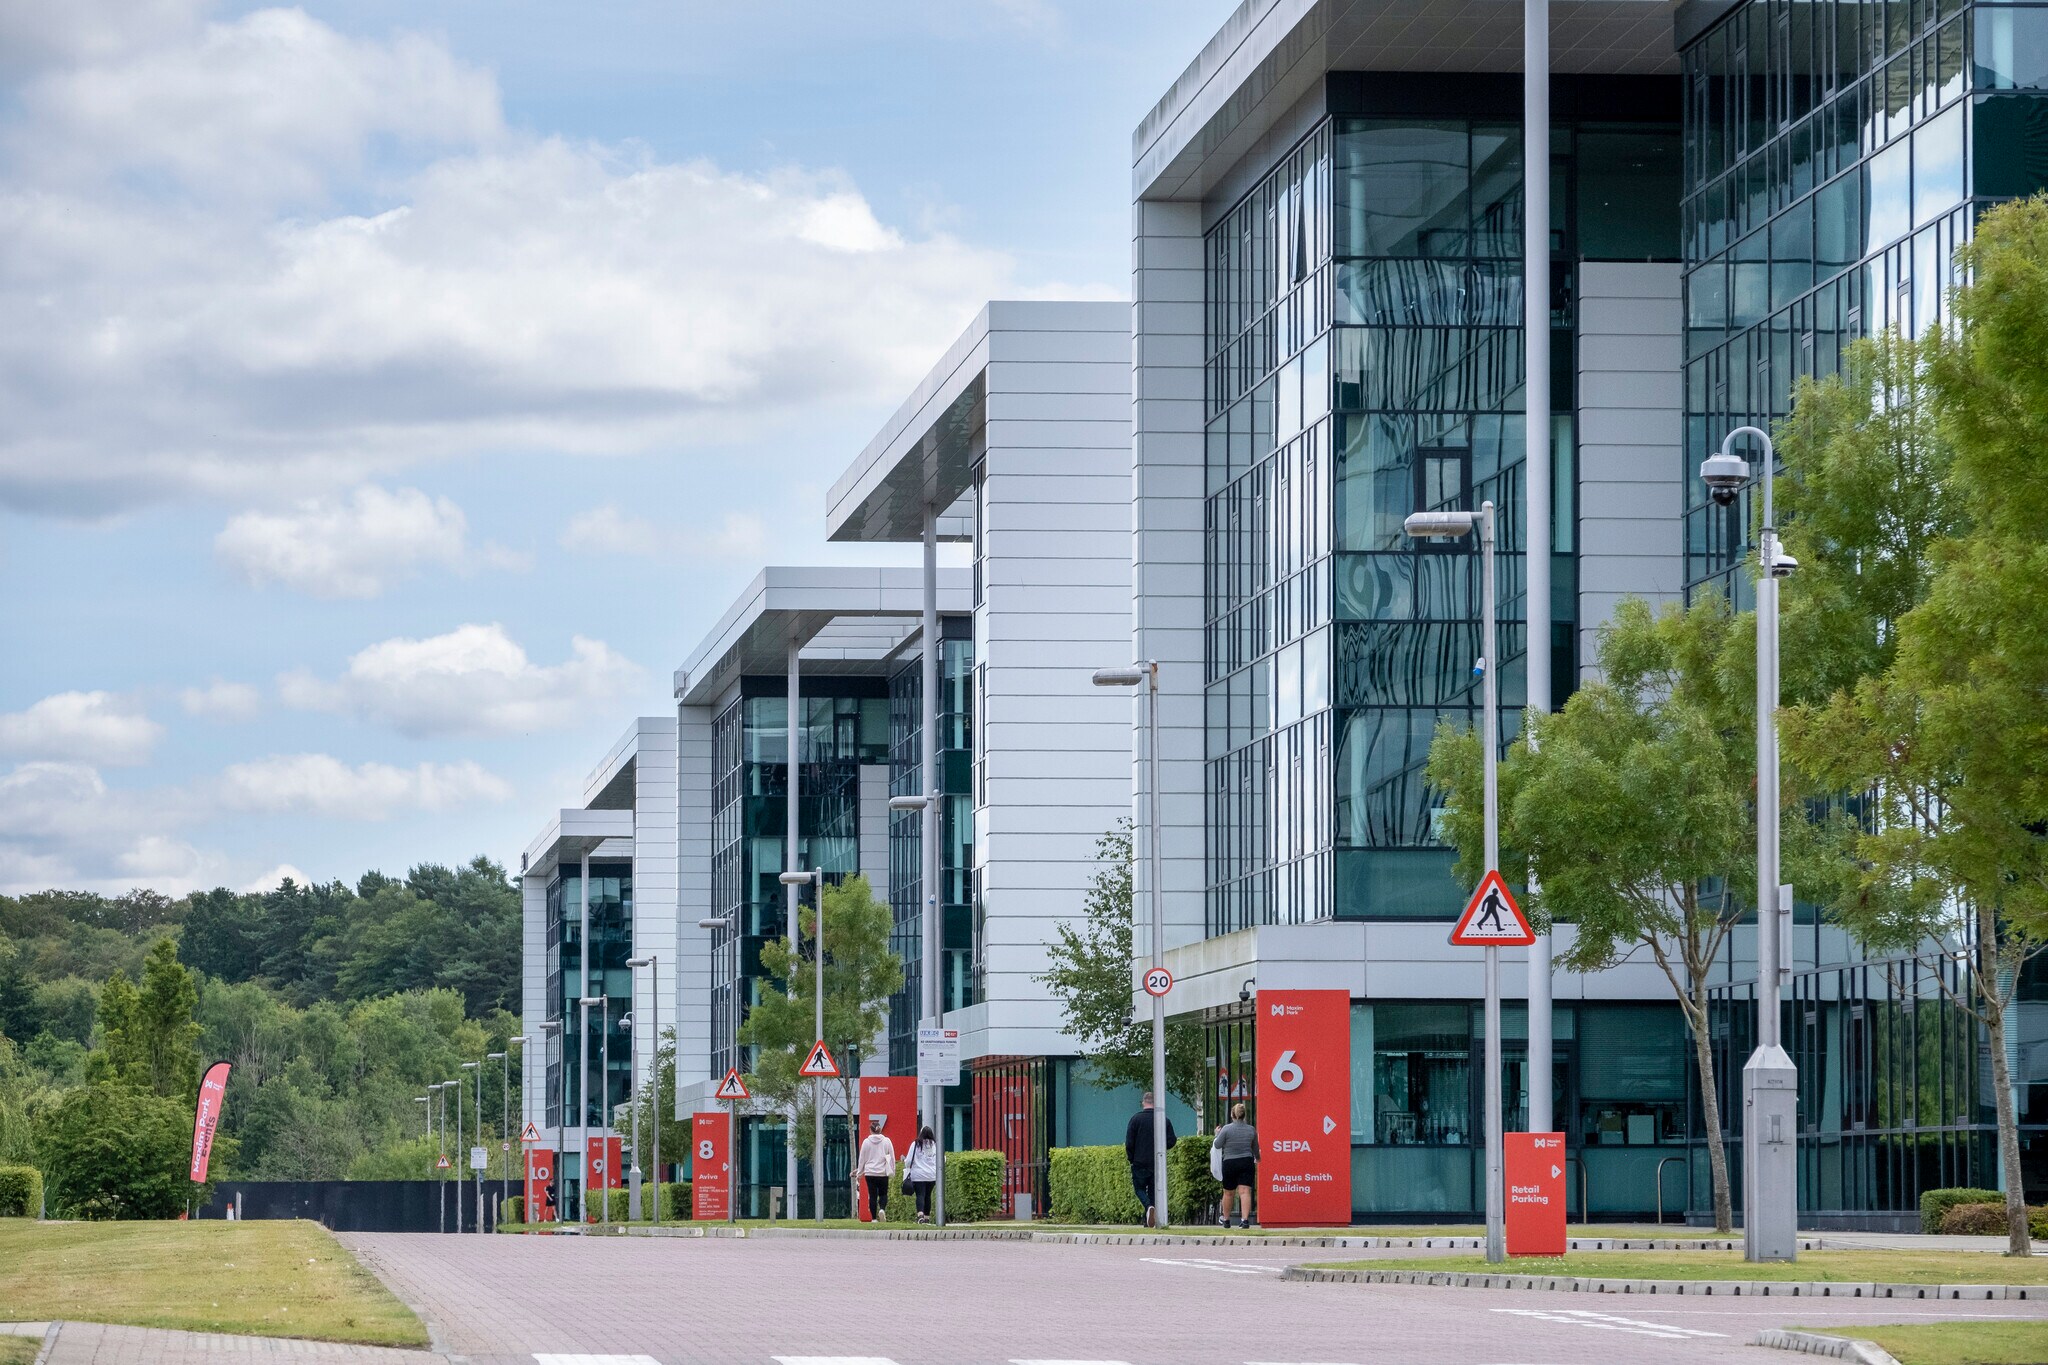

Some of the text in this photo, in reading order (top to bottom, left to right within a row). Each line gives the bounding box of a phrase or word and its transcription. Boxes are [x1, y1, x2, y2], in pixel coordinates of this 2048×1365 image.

[1149, 976, 1169, 988] 20
[1271, 1050, 1304, 1091] 6
[868, 1114, 888, 1133] 7
[194, 1097, 210, 1172] Maxim Park
[202, 1116, 216, 1158] Events
[699, 1140, 714, 1159] 8
[1272, 1140, 1311, 1152] SEPA
[592, 1158, 604, 1174] 9
[532, 1167, 550, 1180] 10
[1272, 1173, 1332, 1183] Angus Smith
[1272, 1184, 1311, 1194] Building
[1512, 1195, 1548, 1204] Parking
